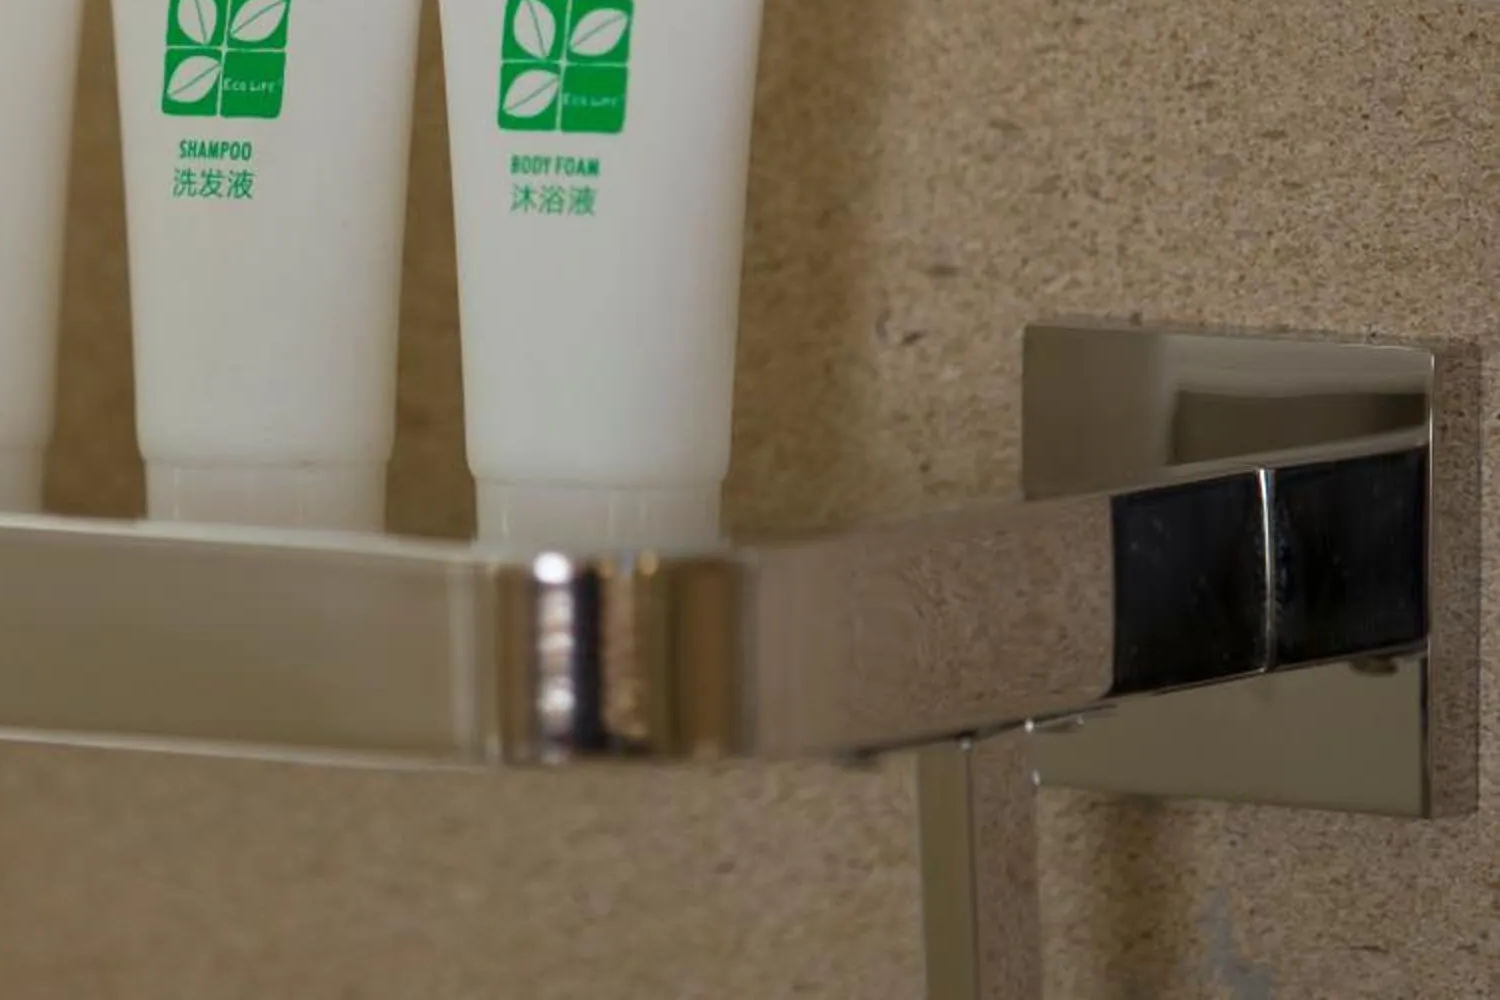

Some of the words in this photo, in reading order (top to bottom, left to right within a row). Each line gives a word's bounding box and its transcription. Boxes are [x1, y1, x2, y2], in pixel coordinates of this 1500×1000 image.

[179, 138, 252, 161] SHAMPOO
[510, 154, 551, 176] BODY
[554, 156, 600, 178] FOAM
[172, 167, 255, 200] 洗发液
[509, 183, 598, 216] 沐浴液
